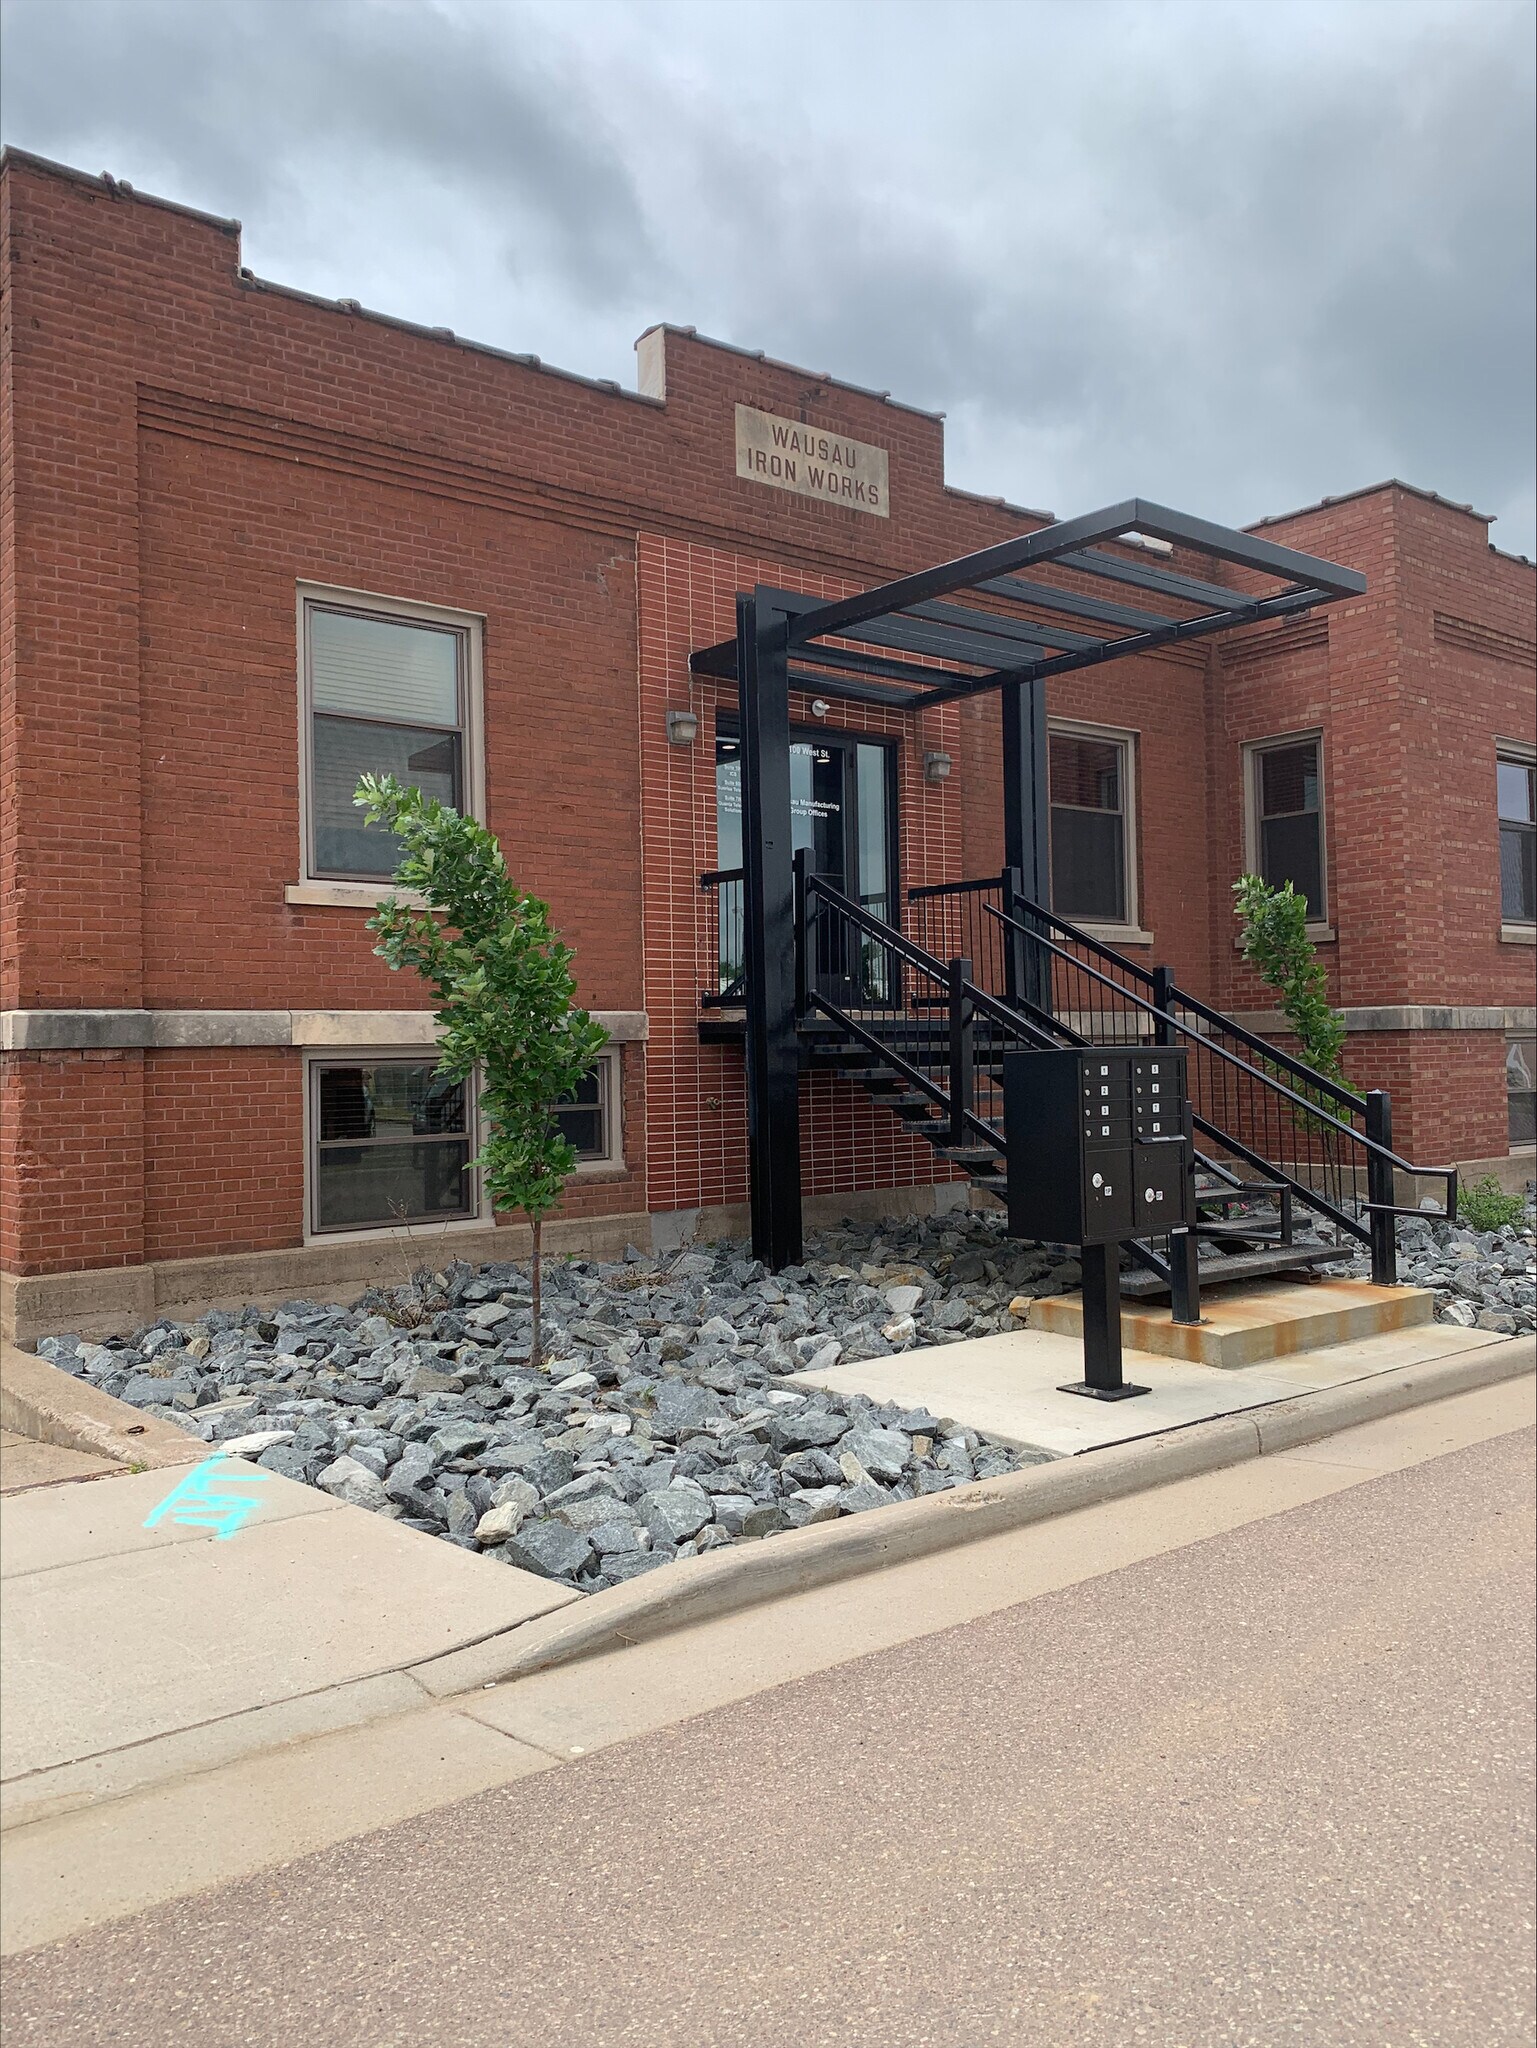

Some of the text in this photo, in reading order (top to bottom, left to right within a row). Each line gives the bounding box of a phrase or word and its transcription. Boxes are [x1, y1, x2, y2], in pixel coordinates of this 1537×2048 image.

[771, 424, 856, 469] WAUSAU
[748, 447, 879, 505] IRON WORKS
[801, 746, 820, 757] West
[820, 749, 831, 759] St.
[800, 799, 840, 811] Manufacturing
[808, 808, 828, 818] Offices
